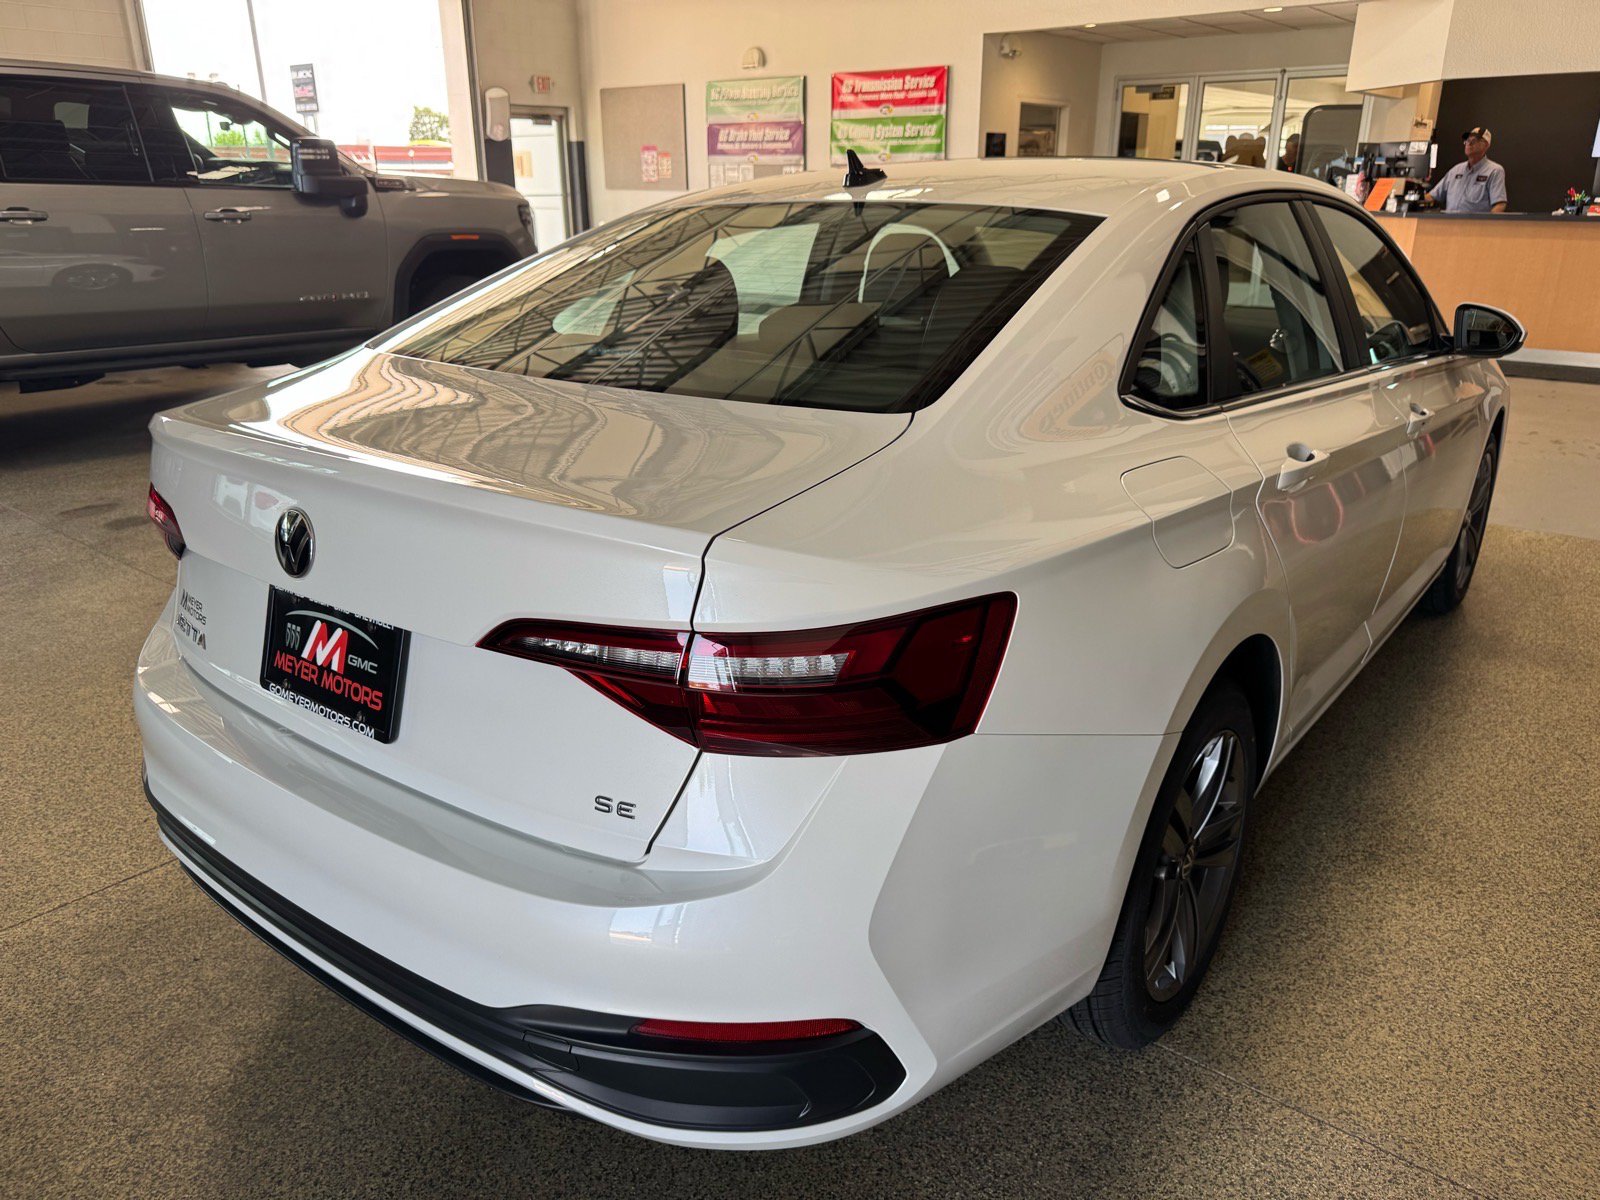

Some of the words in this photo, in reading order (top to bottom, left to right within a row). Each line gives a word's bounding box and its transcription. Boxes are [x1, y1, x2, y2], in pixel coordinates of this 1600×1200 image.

[854, 76, 904, 93] Transmission
[903, 74, 937, 90] Service
[763, 126, 791, 142] Service
[875, 122, 904, 141] System
[904, 121, 937, 138] Service
[347, 654, 379, 675] GMC
[273, 649, 319, 686] MEYER
[320, 670, 384, 712] MOTORS
[268, 682, 375, 740] GOMEYERMOTORS.COM
[594, 795, 637, 820] SE
